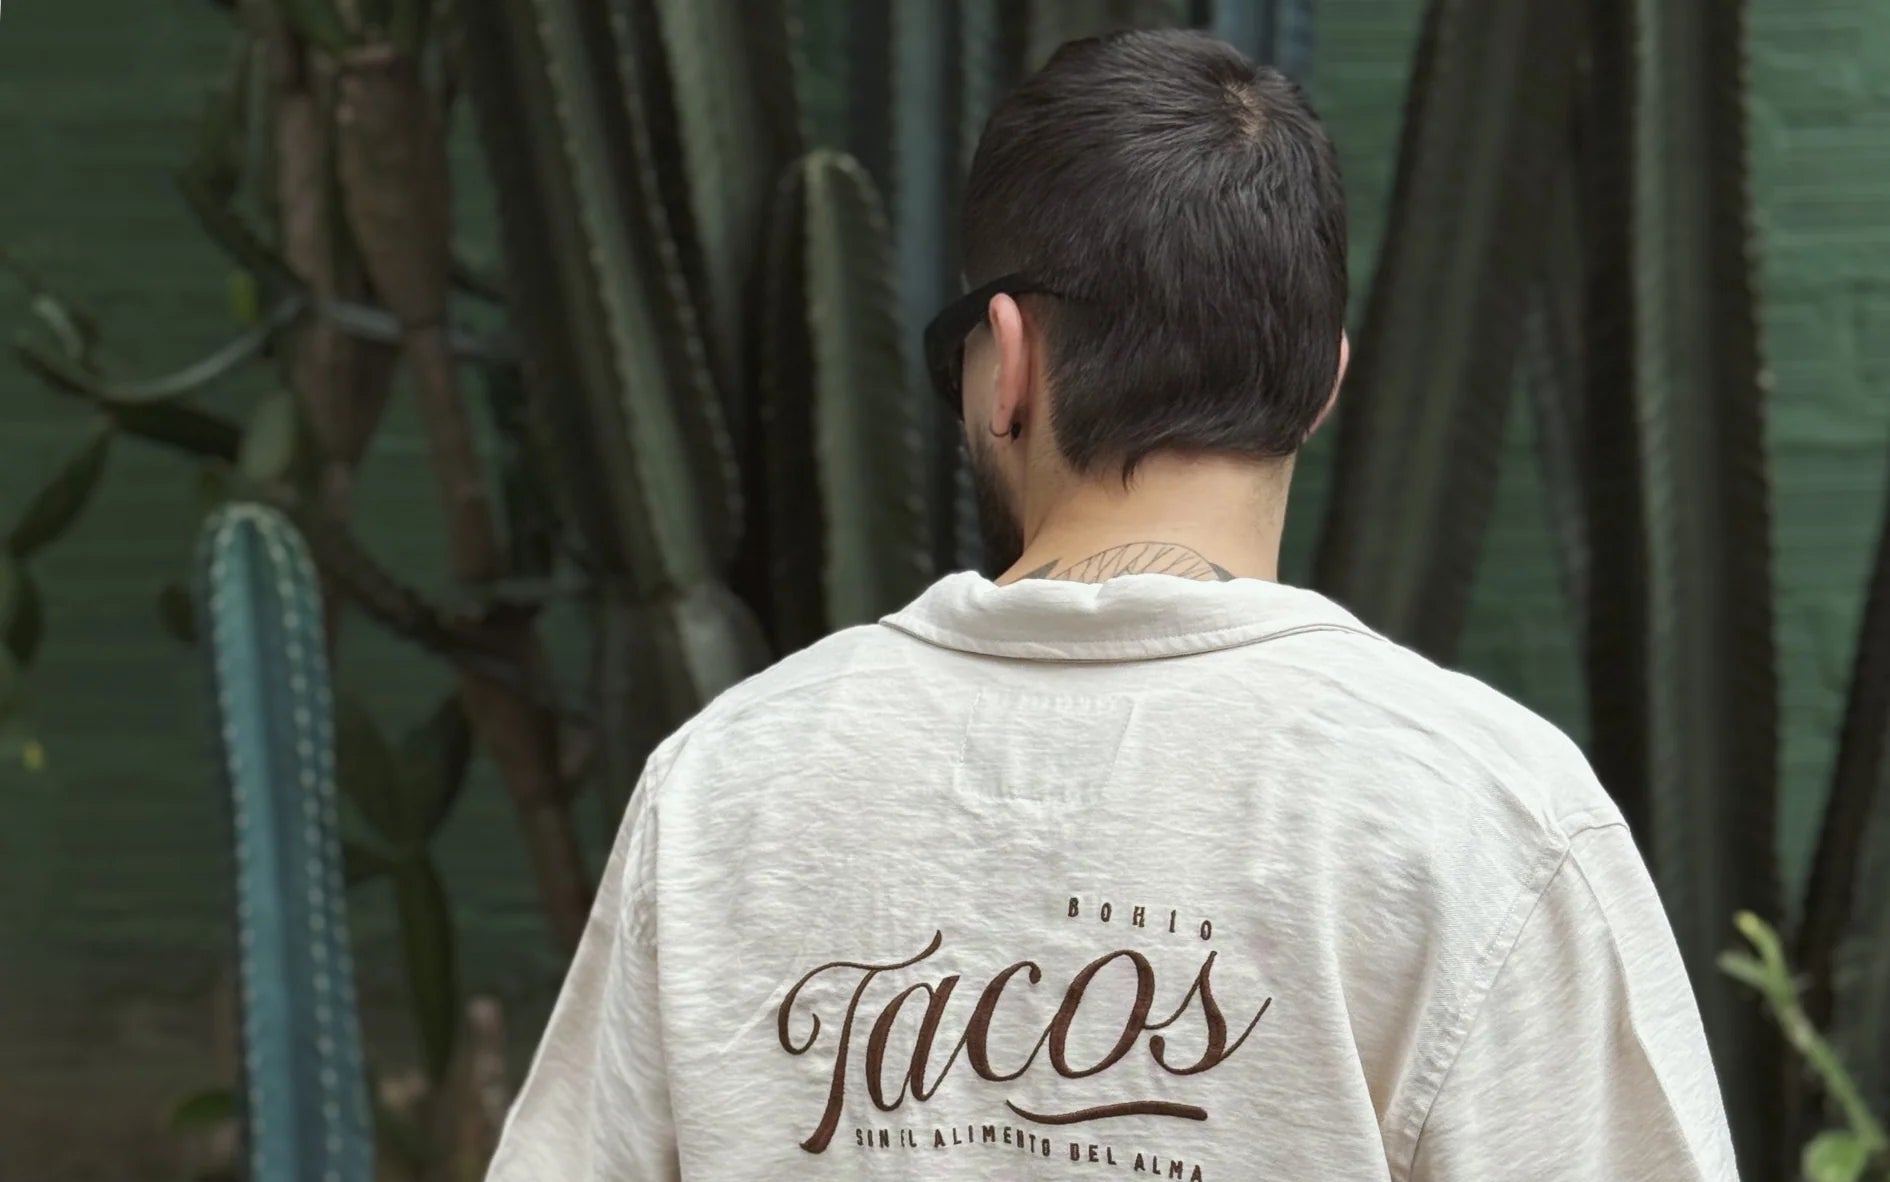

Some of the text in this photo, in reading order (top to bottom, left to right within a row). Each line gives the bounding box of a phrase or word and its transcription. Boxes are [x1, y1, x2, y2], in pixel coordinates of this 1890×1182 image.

[1068, 897, 1212, 941] BOHIO
[777, 929, 1273, 1154] Tacos
[934, 1125, 1051, 1157] ALIMENTO
[1069, 1142, 1117, 1166] DEL
